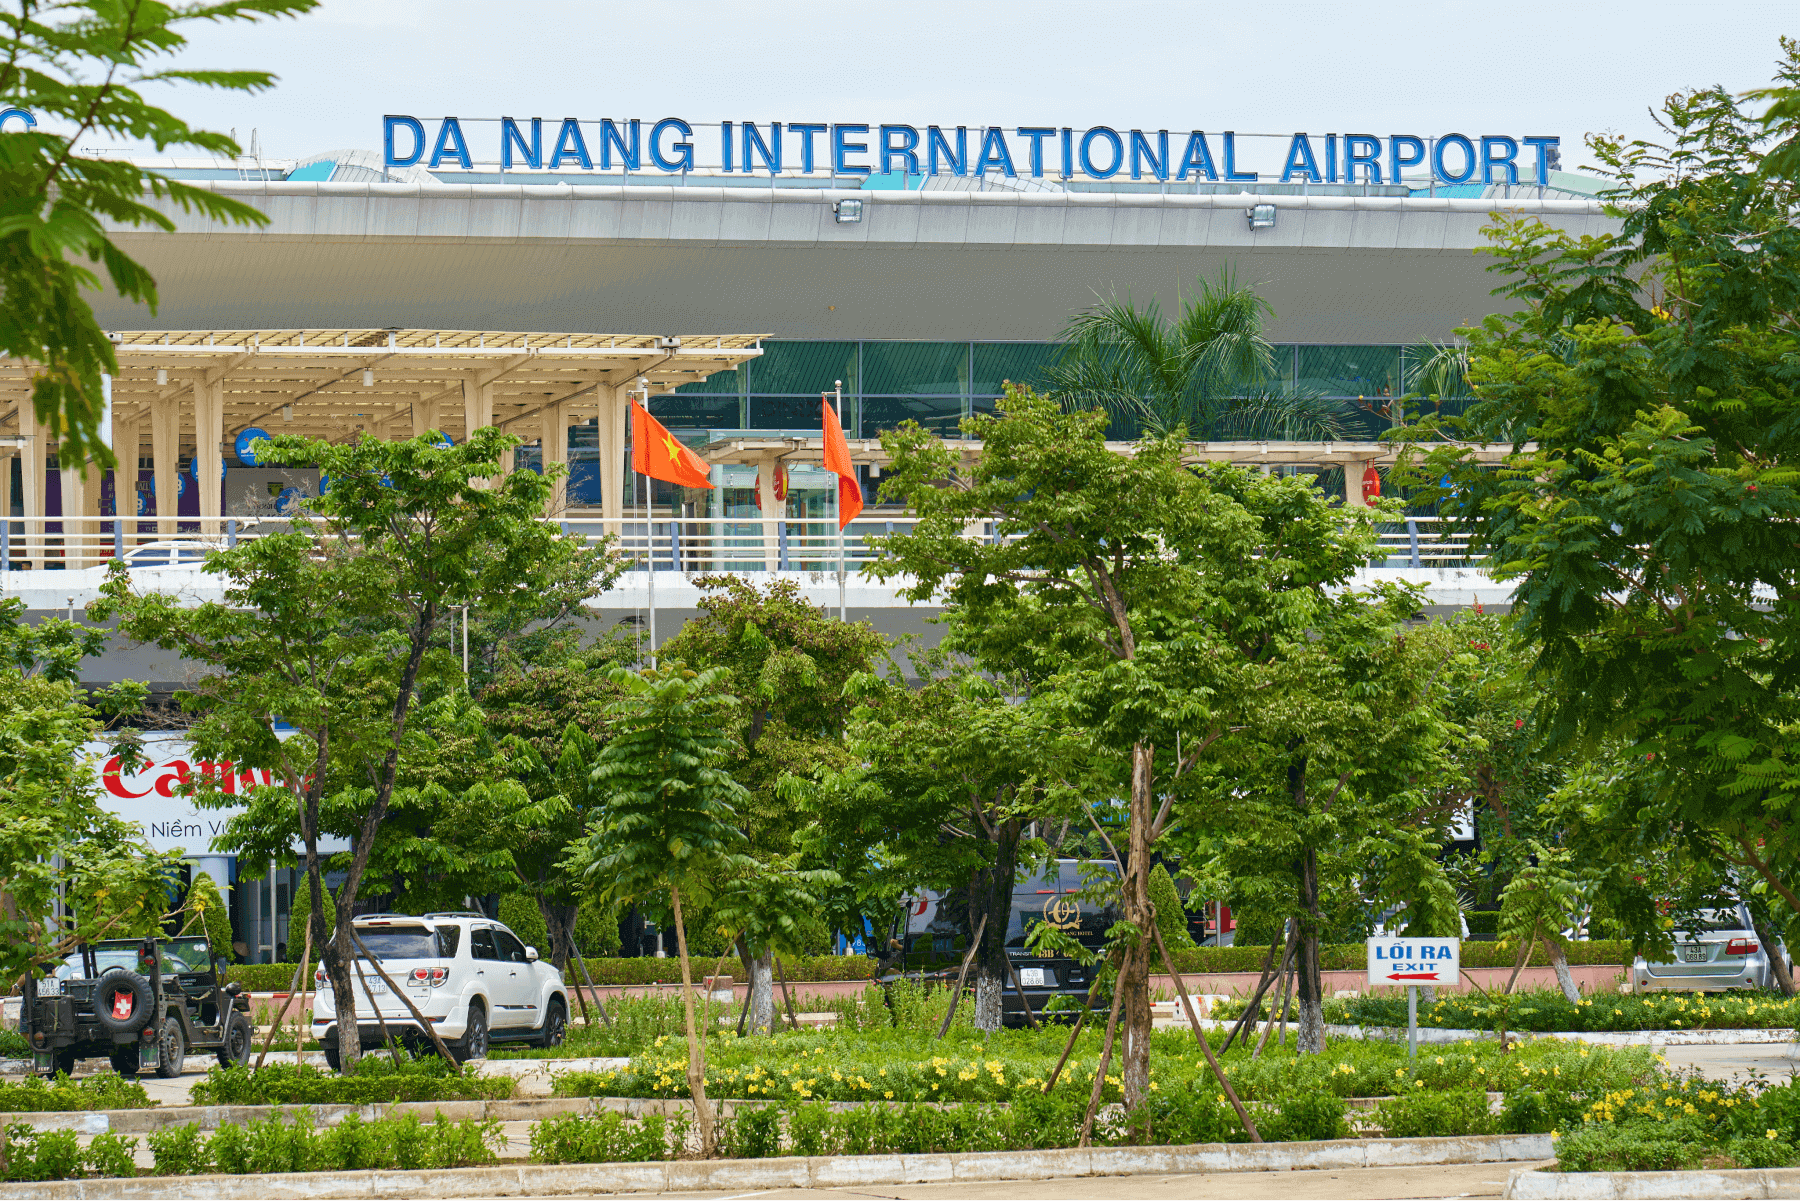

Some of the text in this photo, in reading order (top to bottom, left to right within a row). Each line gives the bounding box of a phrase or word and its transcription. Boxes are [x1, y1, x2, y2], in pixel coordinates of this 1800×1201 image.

[383, 114, 1561, 187] DA NANG INTERNATIONAL AIRPORT
[152, 819, 202, 838] Niềm
[1376, 941, 1452, 959] LỐI RA
[1392, 963, 1438, 971] EXIT
